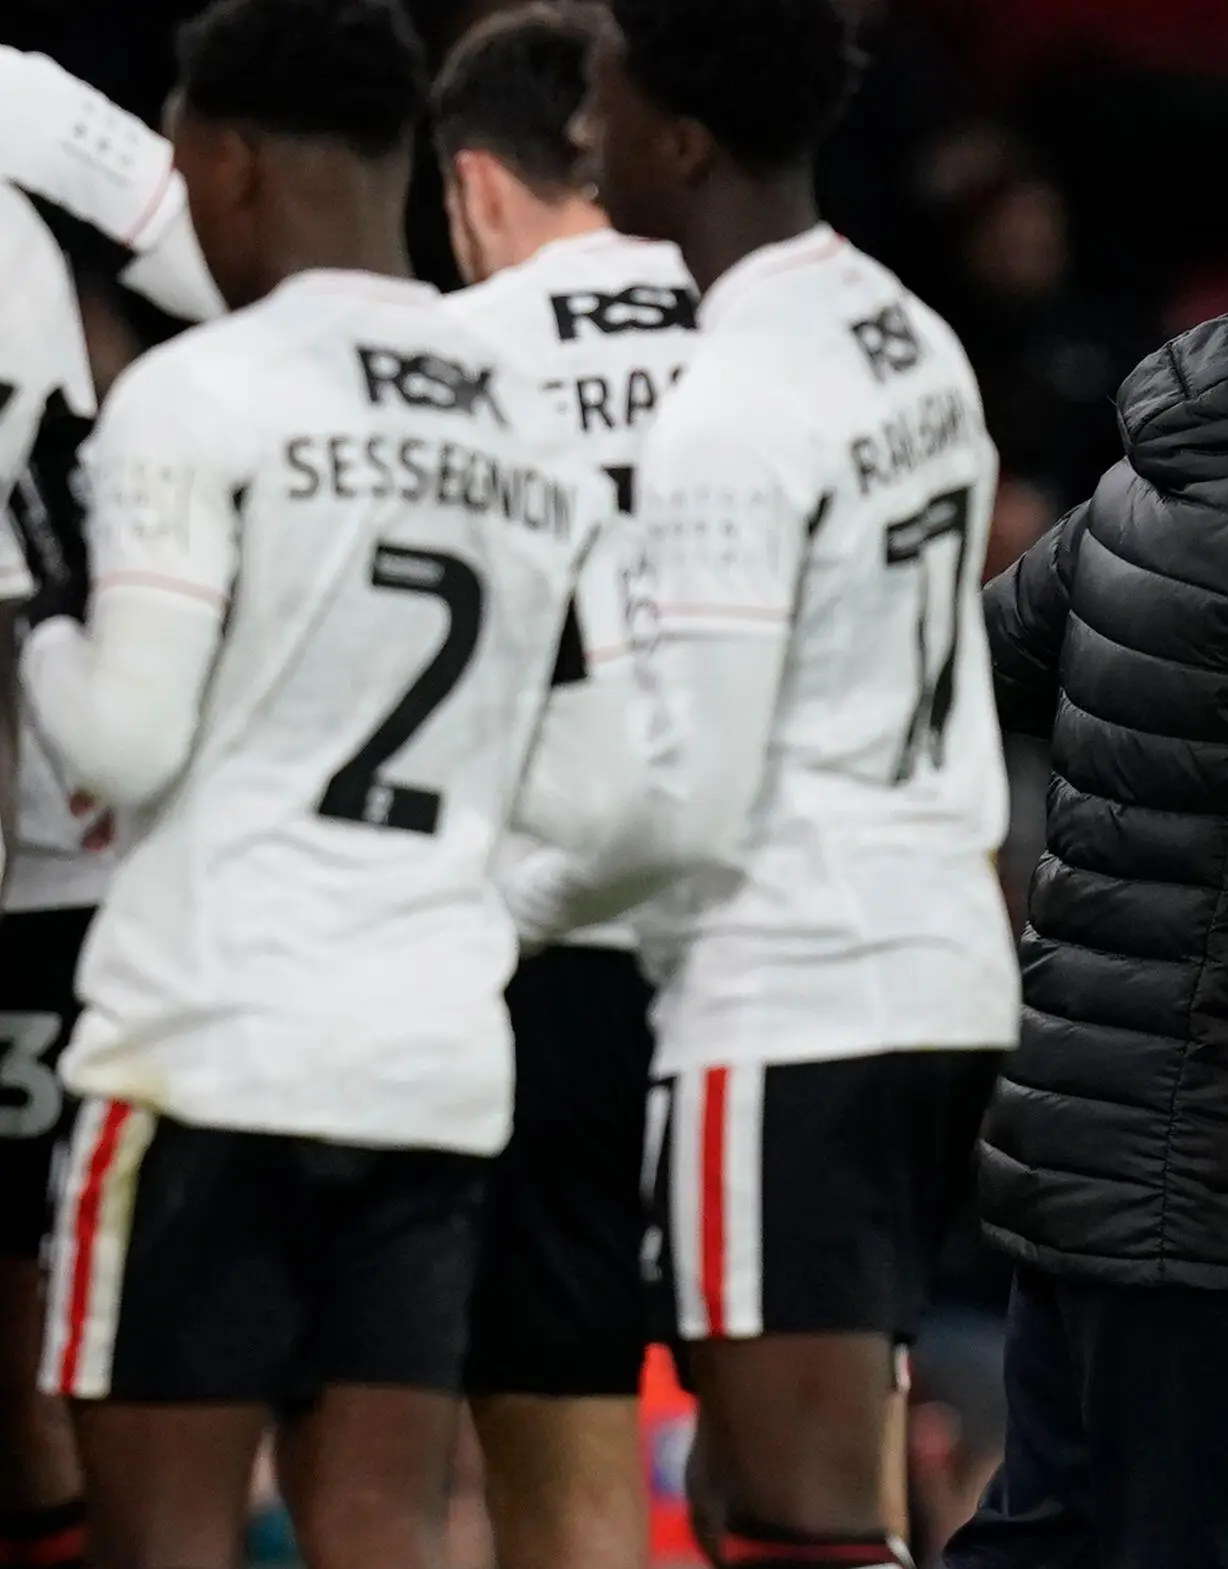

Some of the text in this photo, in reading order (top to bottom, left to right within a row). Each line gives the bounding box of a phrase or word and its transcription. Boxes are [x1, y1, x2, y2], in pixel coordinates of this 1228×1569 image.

[850, 302, 923, 384] RS
[355, 345, 511, 430] RSK
[315, 541, 482, 836] 2
